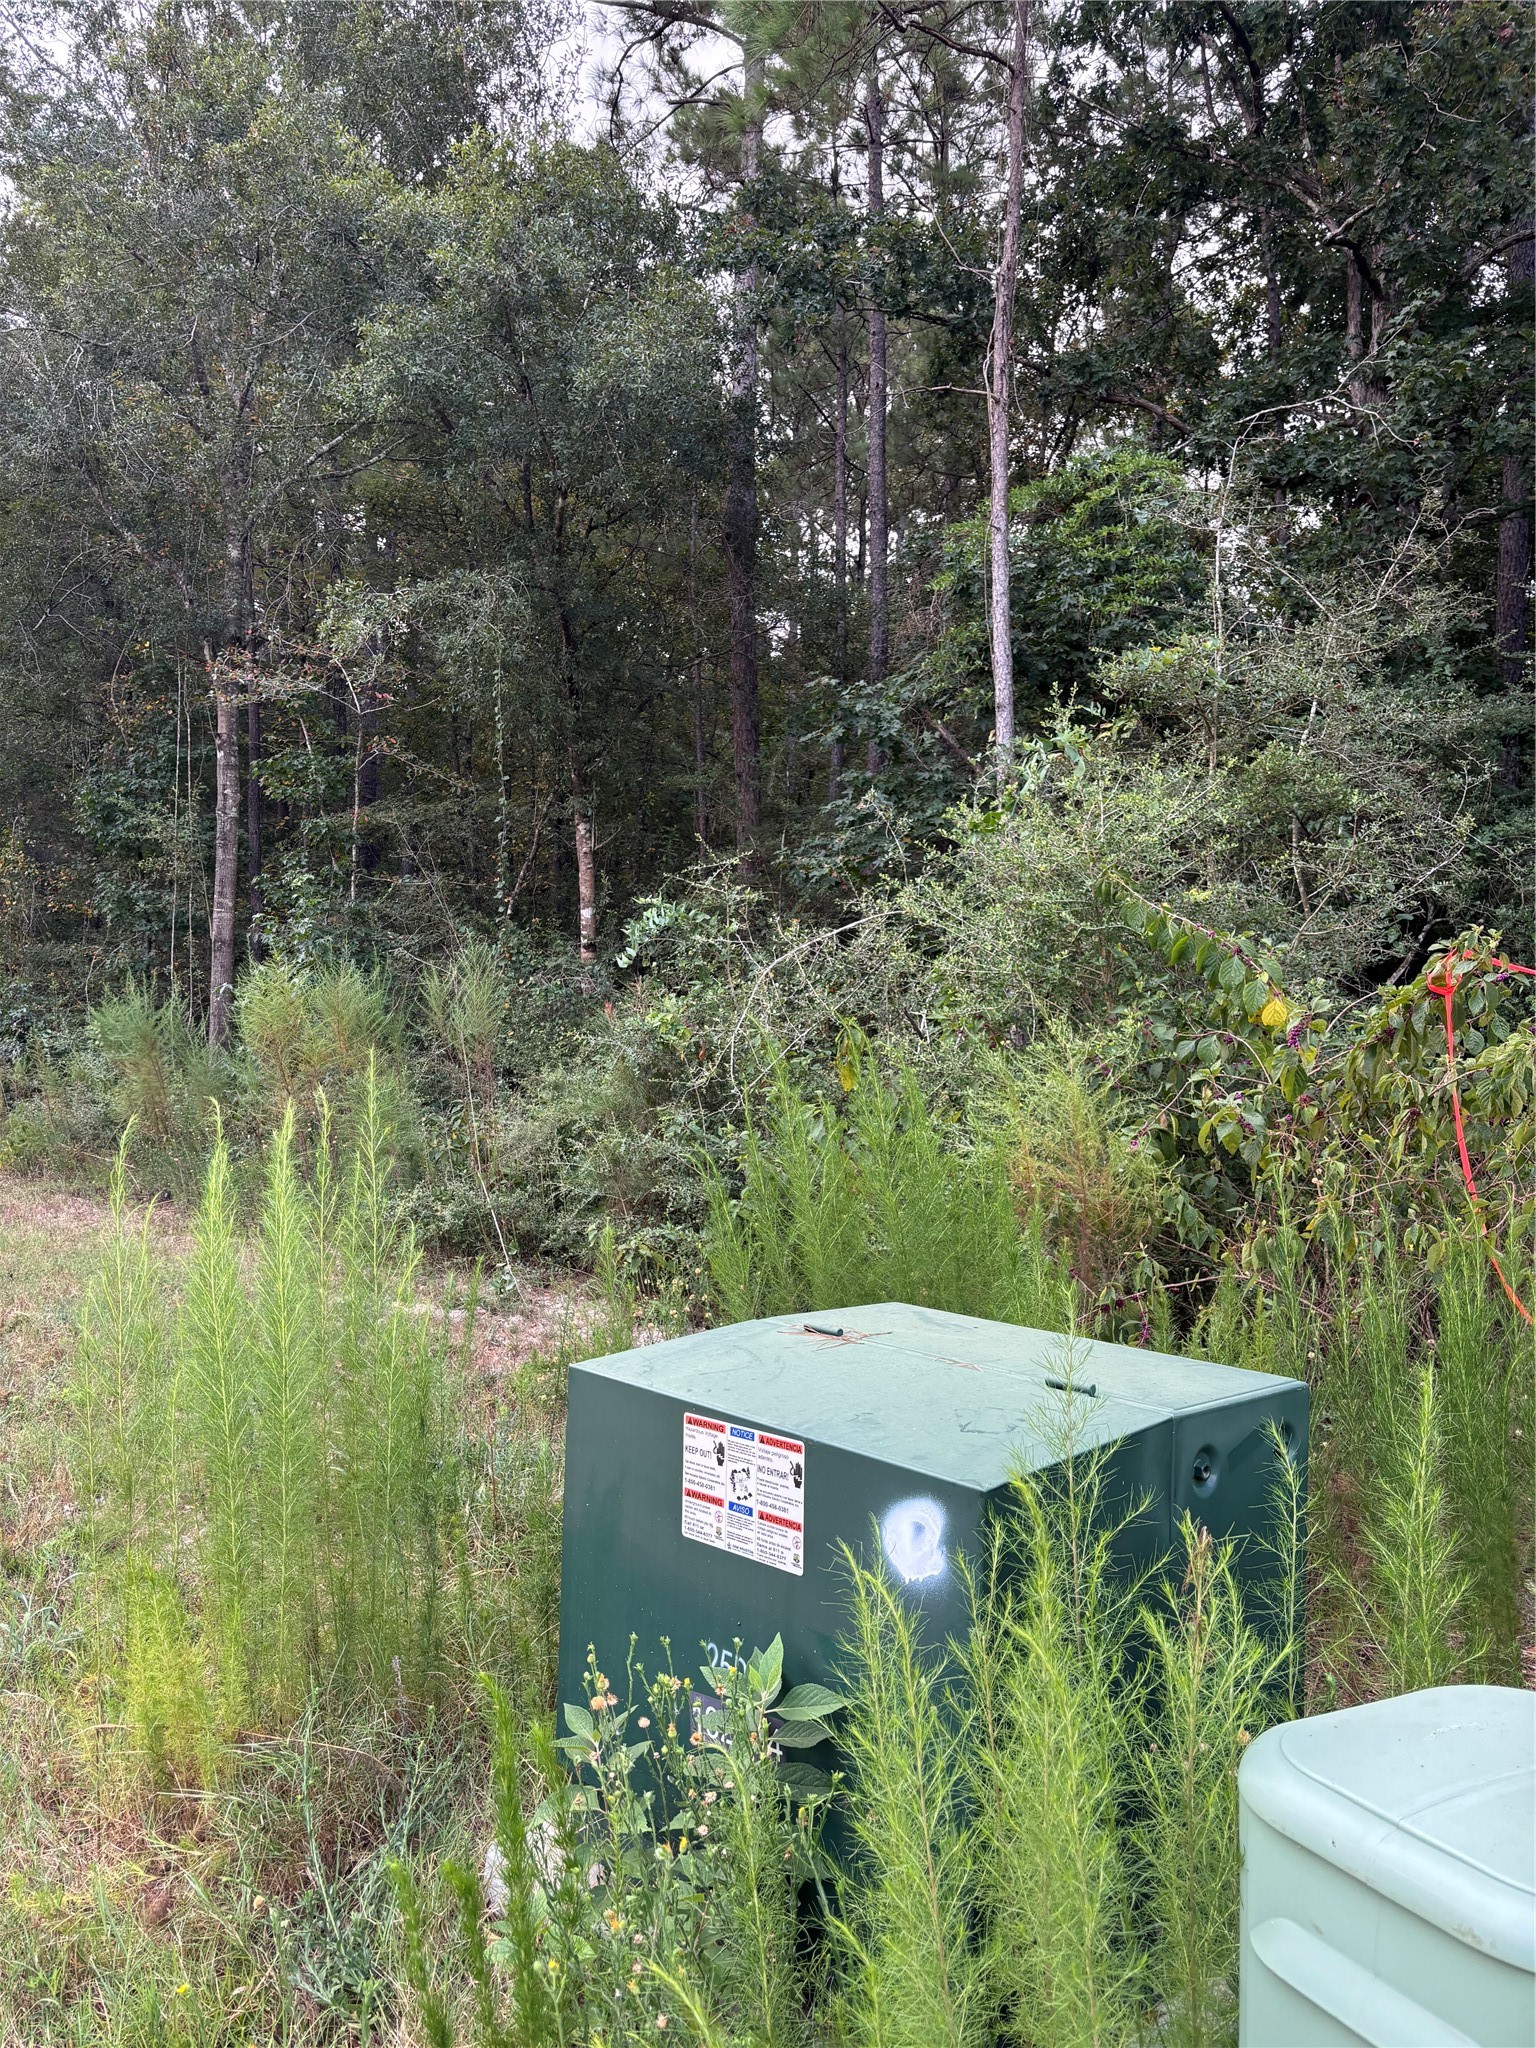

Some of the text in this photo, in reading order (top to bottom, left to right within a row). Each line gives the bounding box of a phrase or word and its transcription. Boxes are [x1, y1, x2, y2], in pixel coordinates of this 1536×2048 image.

[693, 1418, 723, 1432] WARNING
[731, 1427, 752, 1439] NOTICE
[685, 1444, 711, 1459] KEEP OUT!
[765, 1437, 801, 1452] ADVERTENCIA
[692, 1490, 722, 1506] WARNING
[732, 1503, 749, 1515] AVISO
[765, 1513, 801, 1531] ADVERTENCIA
